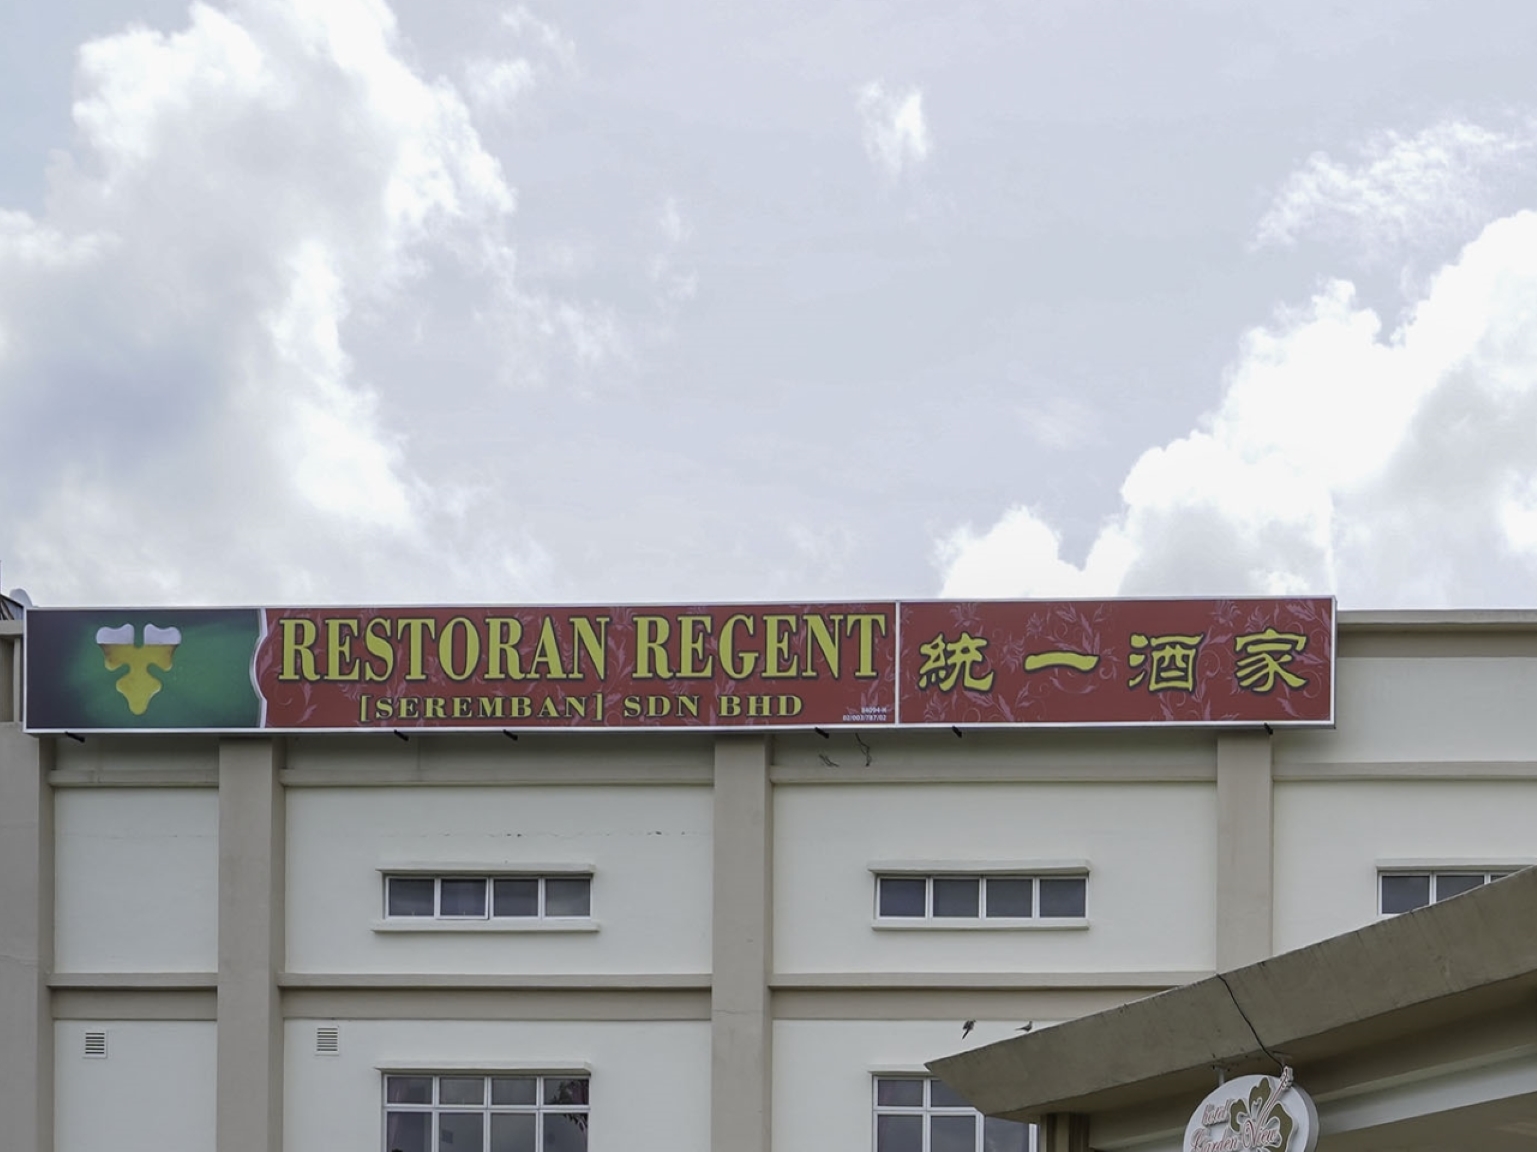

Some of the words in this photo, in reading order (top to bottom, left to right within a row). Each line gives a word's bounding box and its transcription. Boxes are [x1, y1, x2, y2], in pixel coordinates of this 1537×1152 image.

[278, 616, 611, 682] RESTORAN
[631, 613, 887, 681] REGENT
[918, 627, 1309, 693] 統一酒家
[359, 692, 604, 722] [SEREMBAN]
[624, 695, 699, 718] SDN
[718, 694, 803, 717] BHD
[1243, 1119, 1276, 1150] View
